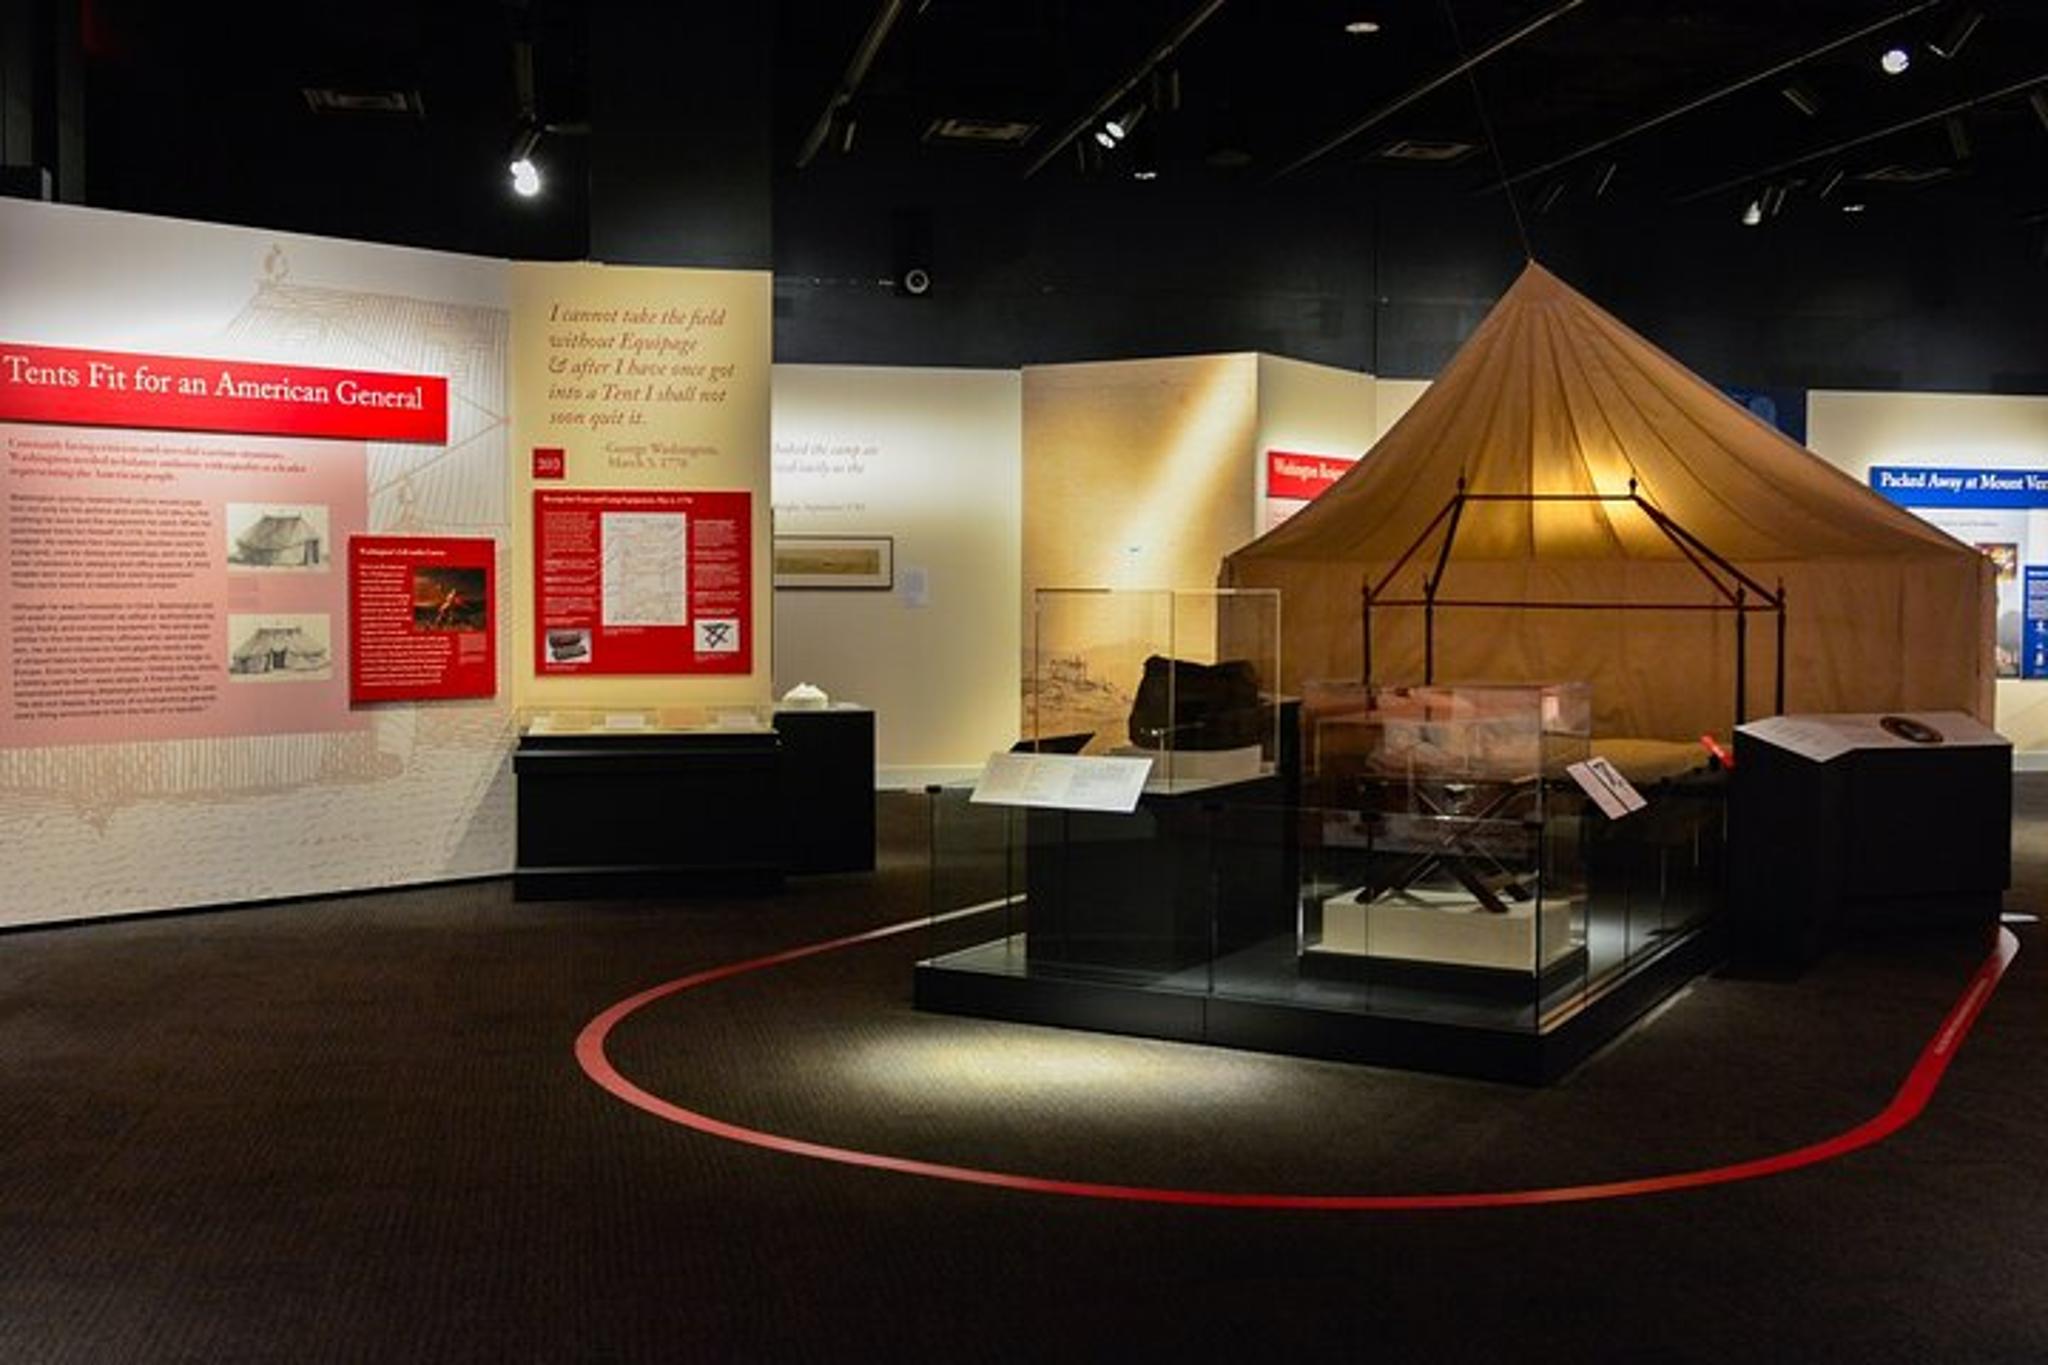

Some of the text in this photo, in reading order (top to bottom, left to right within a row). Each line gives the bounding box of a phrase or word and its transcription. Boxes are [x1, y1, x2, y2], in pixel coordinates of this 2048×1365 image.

[549, 304, 726, 332] I cannot take the field
[549, 332, 698, 356] without Equipage
[571, 359, 610, 381] after
[615, 358, 625, 376] I
[628, 359, 668, 377] have
[671, 364, 704, 378] once
[708, 363, 735, 382] got
[3, 355, 424, 411] Tents Fit for an American General
[548, 383, 727, 403] into a Tent I shall not
[549, 410, 648, 430] soon quit it.
[1880, 471, 1926, 488] Packed
[1928, 472, 1963, 493] Away
[1965, 477, 1978, 488] at
[1980, 474, 2023, 490] Mount
